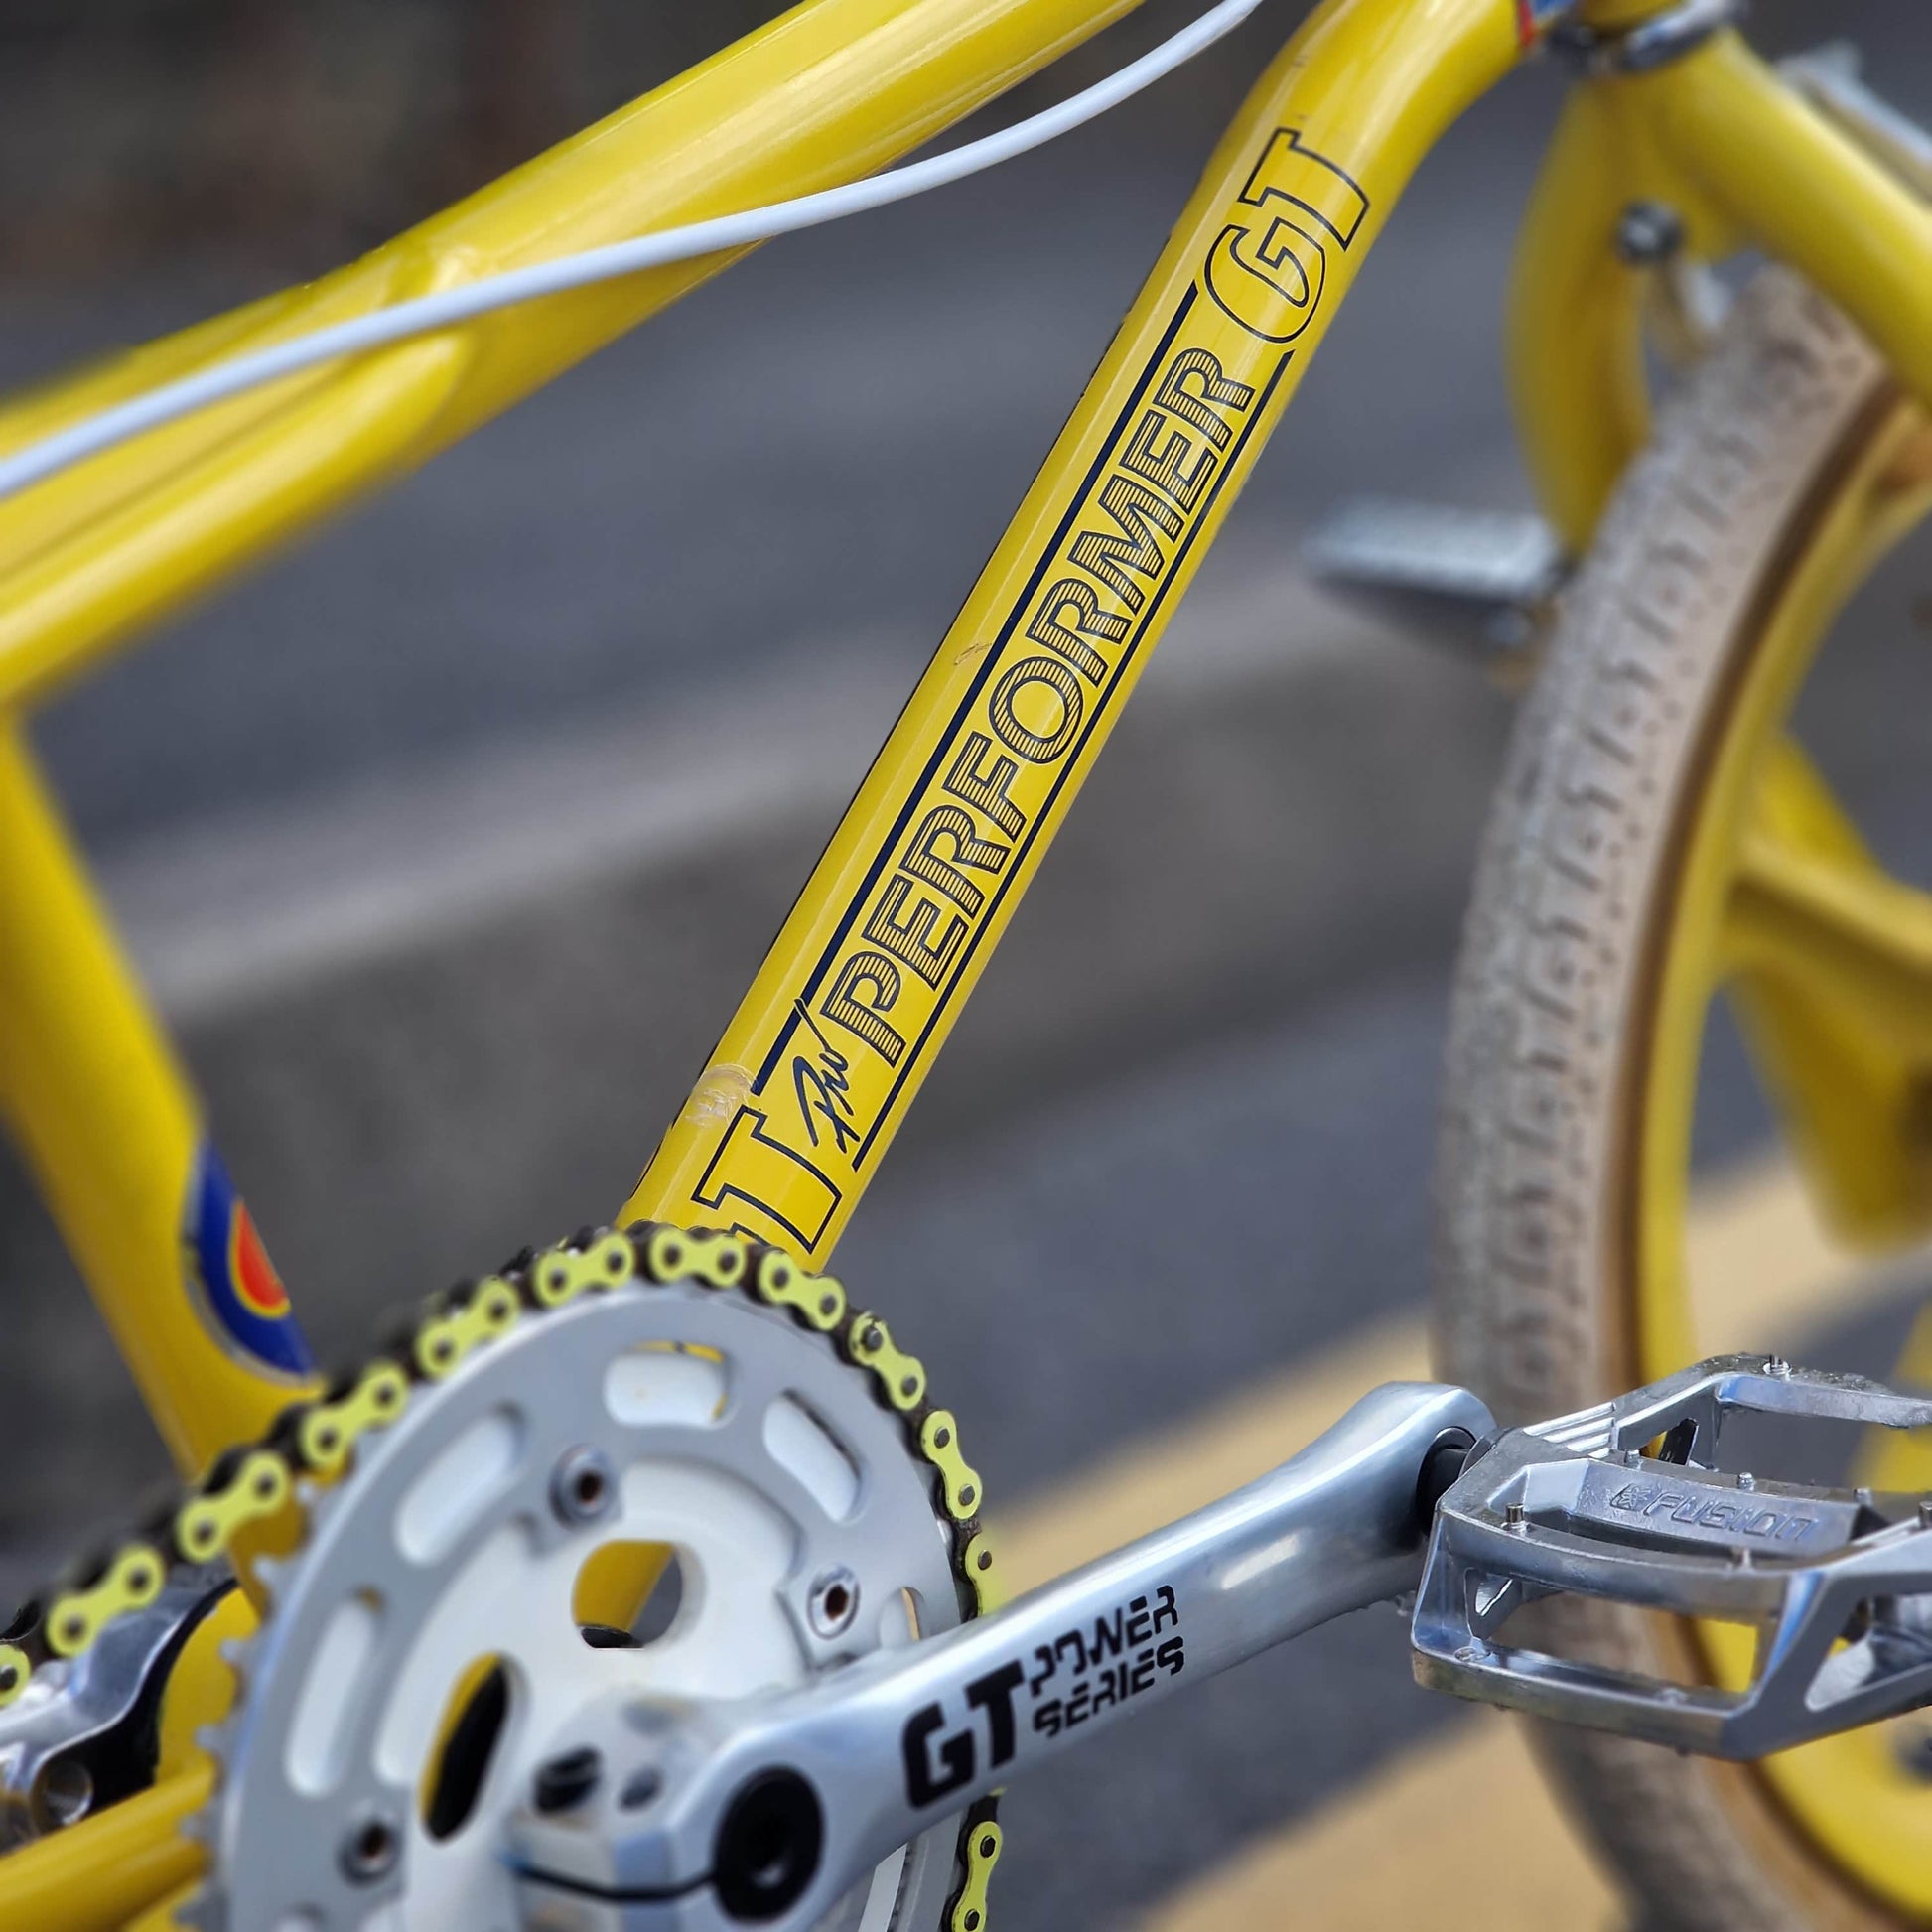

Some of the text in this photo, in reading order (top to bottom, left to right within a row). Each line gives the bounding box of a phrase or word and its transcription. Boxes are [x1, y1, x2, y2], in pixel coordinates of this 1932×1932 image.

[1204, 127, 1370, 343] GT
[792, 347, 1256, 1153] Pro PERFORMER
[691, 1104, 843, 1254] T
[901, 1585, 1178, 1811] GT POWER
[1033, 1636, 1184, 1738] SERIES
